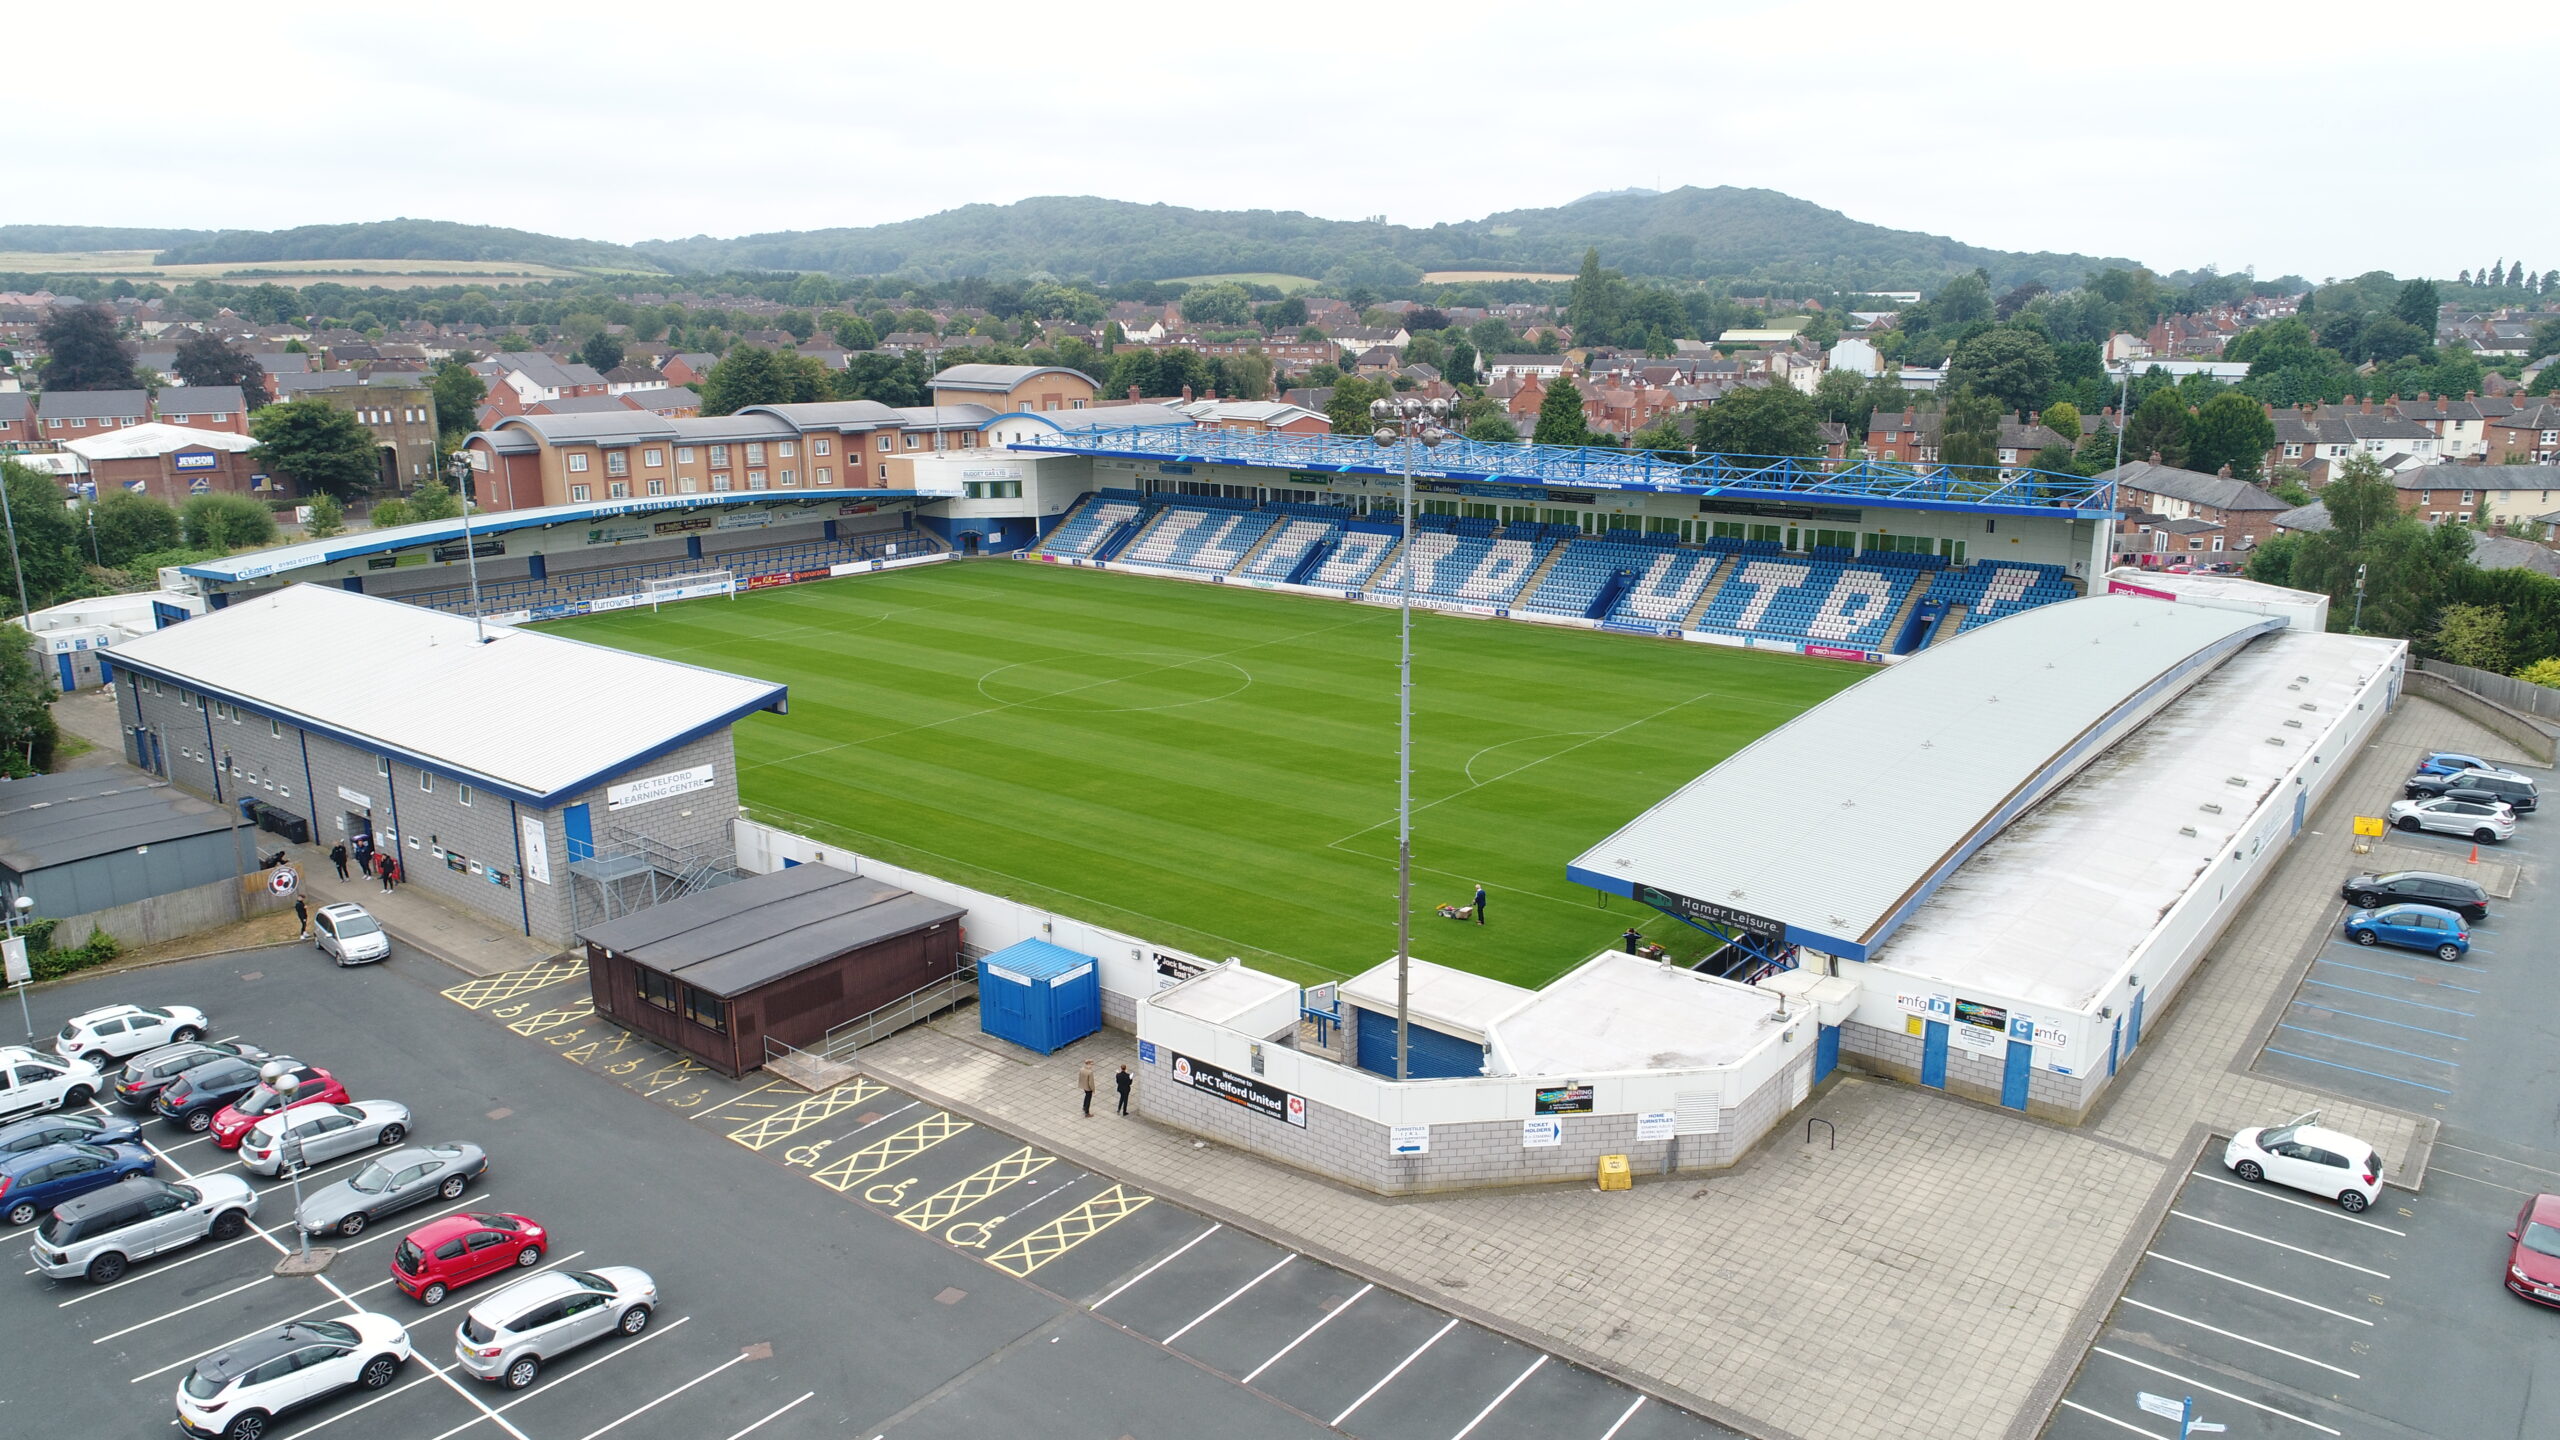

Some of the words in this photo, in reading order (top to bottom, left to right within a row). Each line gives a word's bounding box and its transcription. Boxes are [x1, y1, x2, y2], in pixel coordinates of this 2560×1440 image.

[178, 456, 214, 466] JEWSON
[1542, 479, 1571, 487] University
[1578, 481, 1622, 489] Wolverhampton
[593, 507, 625, 517] FRANK
[633, 500, 688, 512] NAGINGTON
[695, 497, 725, 506] STAND
[728, 514, 747, 522] Archer
[748, 511, 769, 520] Security
[800, 569, 830, 578] vanarama
[594, 597, 631, 609] furrows
[1364, 594, 1382, 602] NEW
[1408, 598, 1428, 608] HEAD
[1429, 601, 1464, 611] STADIUM
[631, 781, 649, 793] AFC
[652, 772, 692, 787] TELFORD
[619, 789, 667, 806] LEARNING
[669, 779, 704, 793] CENTRE
[1681, 897, 1727, 917] Hamer
[1730, 911, 1777, 932] Leisure
[1162, 957, 1178, 969] Jack
[1902, 995, 1927, 1011] mfg
[1933, 1000, 1945, 1012] D
[2015, 1020, 2028, 1033] C
[2039, 1029, 2066, 1046] mfg
[1221, 1071, 1245, 1085] Welcome
[1246, 1079, 1253, 1088] to
[1195, 1071, 1214, 1085] AFC
[1214, 1077, 1247, 1099] Telford
[1249, 1090, 1282, 1111] United
